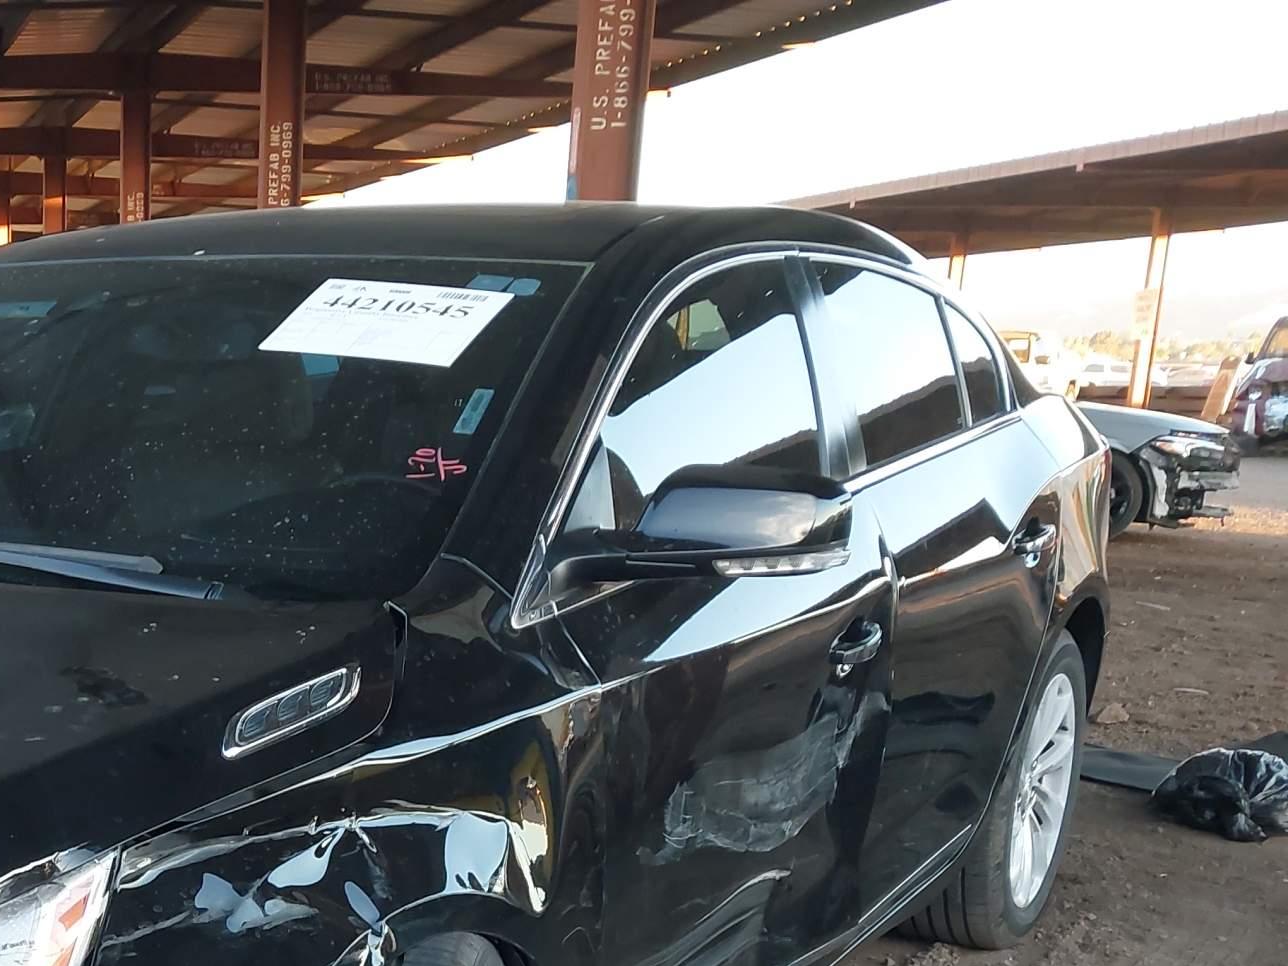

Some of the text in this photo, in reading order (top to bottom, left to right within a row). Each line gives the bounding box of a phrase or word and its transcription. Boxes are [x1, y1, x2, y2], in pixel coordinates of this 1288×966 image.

[591, 0, 616, 131] U.S. PREFA
[268, 152, 280, 206] PREFAB
[323, 295, 477, 319] 44210545
